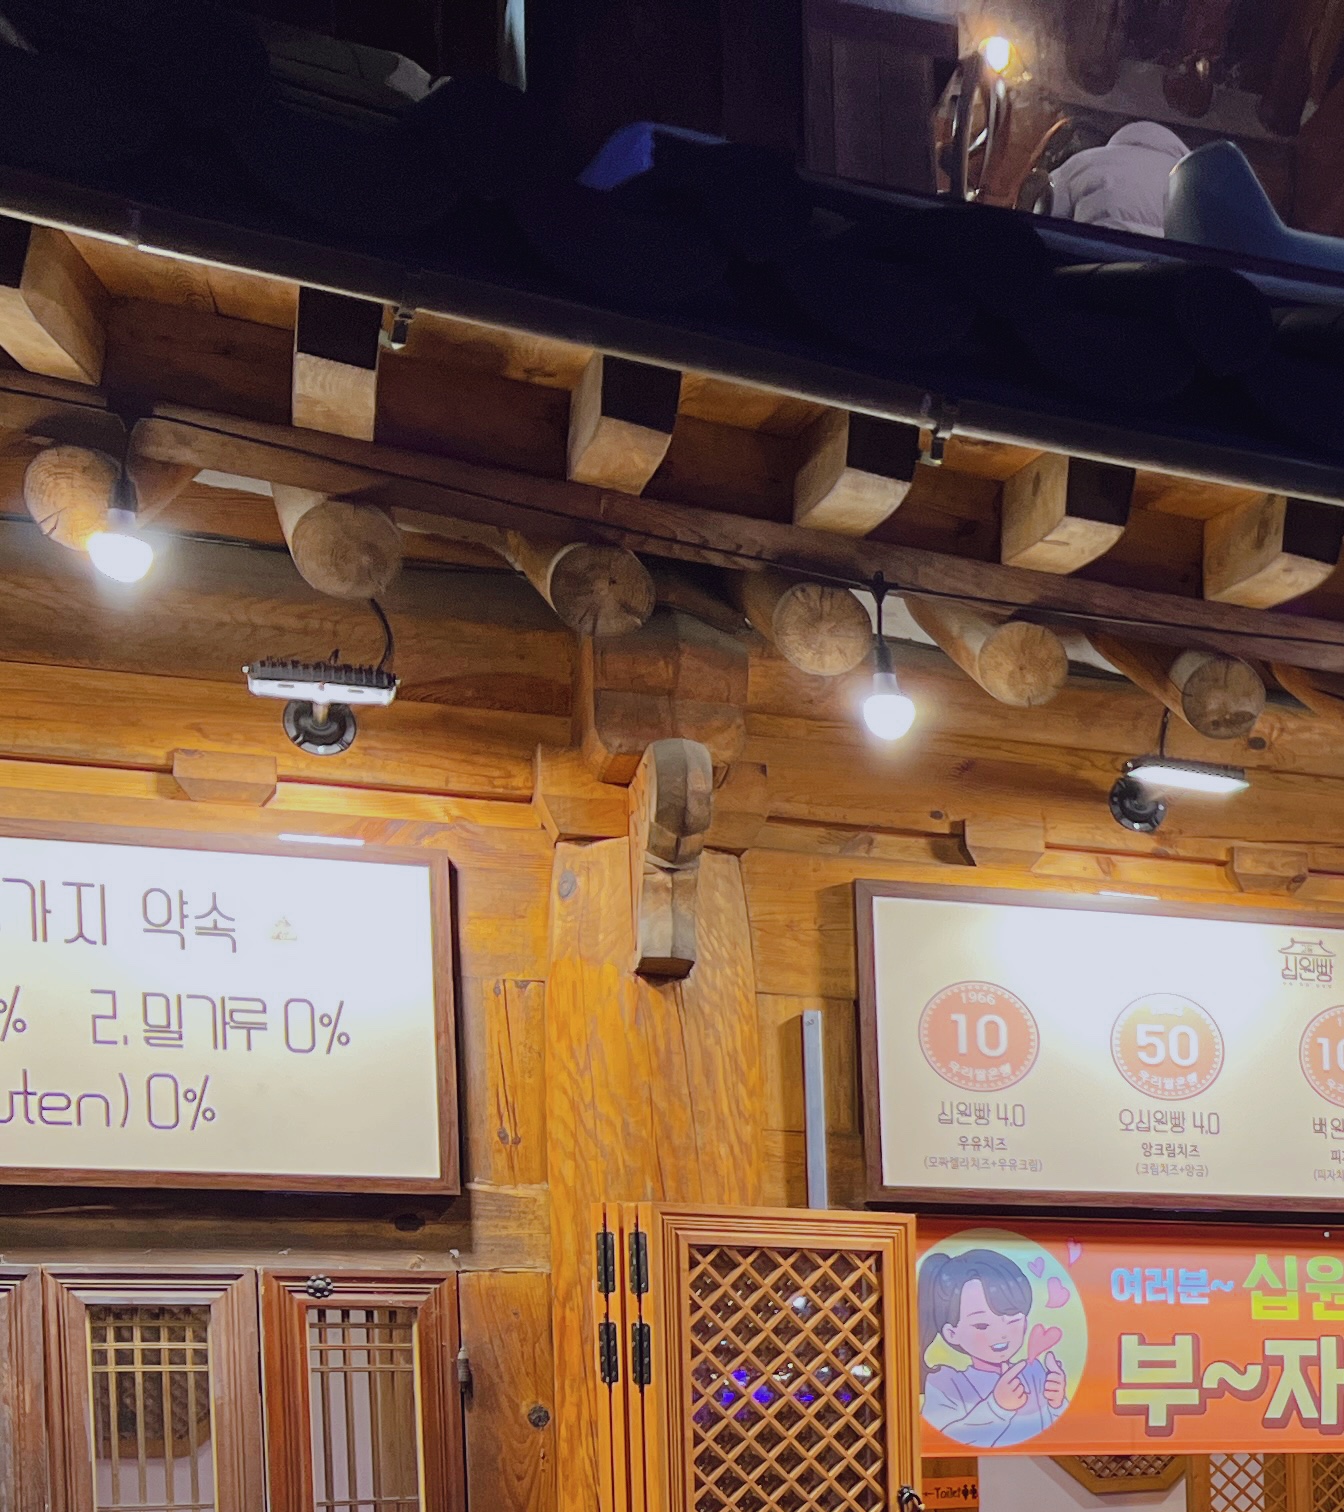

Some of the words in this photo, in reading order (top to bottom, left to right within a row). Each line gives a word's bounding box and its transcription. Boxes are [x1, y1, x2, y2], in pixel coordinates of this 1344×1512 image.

[2, 877, 108, 946] 가지
[141, 887, 237, 953] 약속
[950, 1013, 1009, 1058] 10
[1135, 1023, 1200, 1067] 50
[937, 1100, 992, 1127] 십원빵
[996, 1102, 1026, 1128] 4.0
[1118, 1108, 1186, 1134] 오십원빵
[1192, 1111, 1220, 1135] 4.0
[957, 1135, 1009, 1152] 우유치즈
[1141, 1141, 1201, 1159] 앙크림치즈
[1110, 1266, 1234, 1307] 여러분~
[934, 1486, 961, 1499] Toilet
